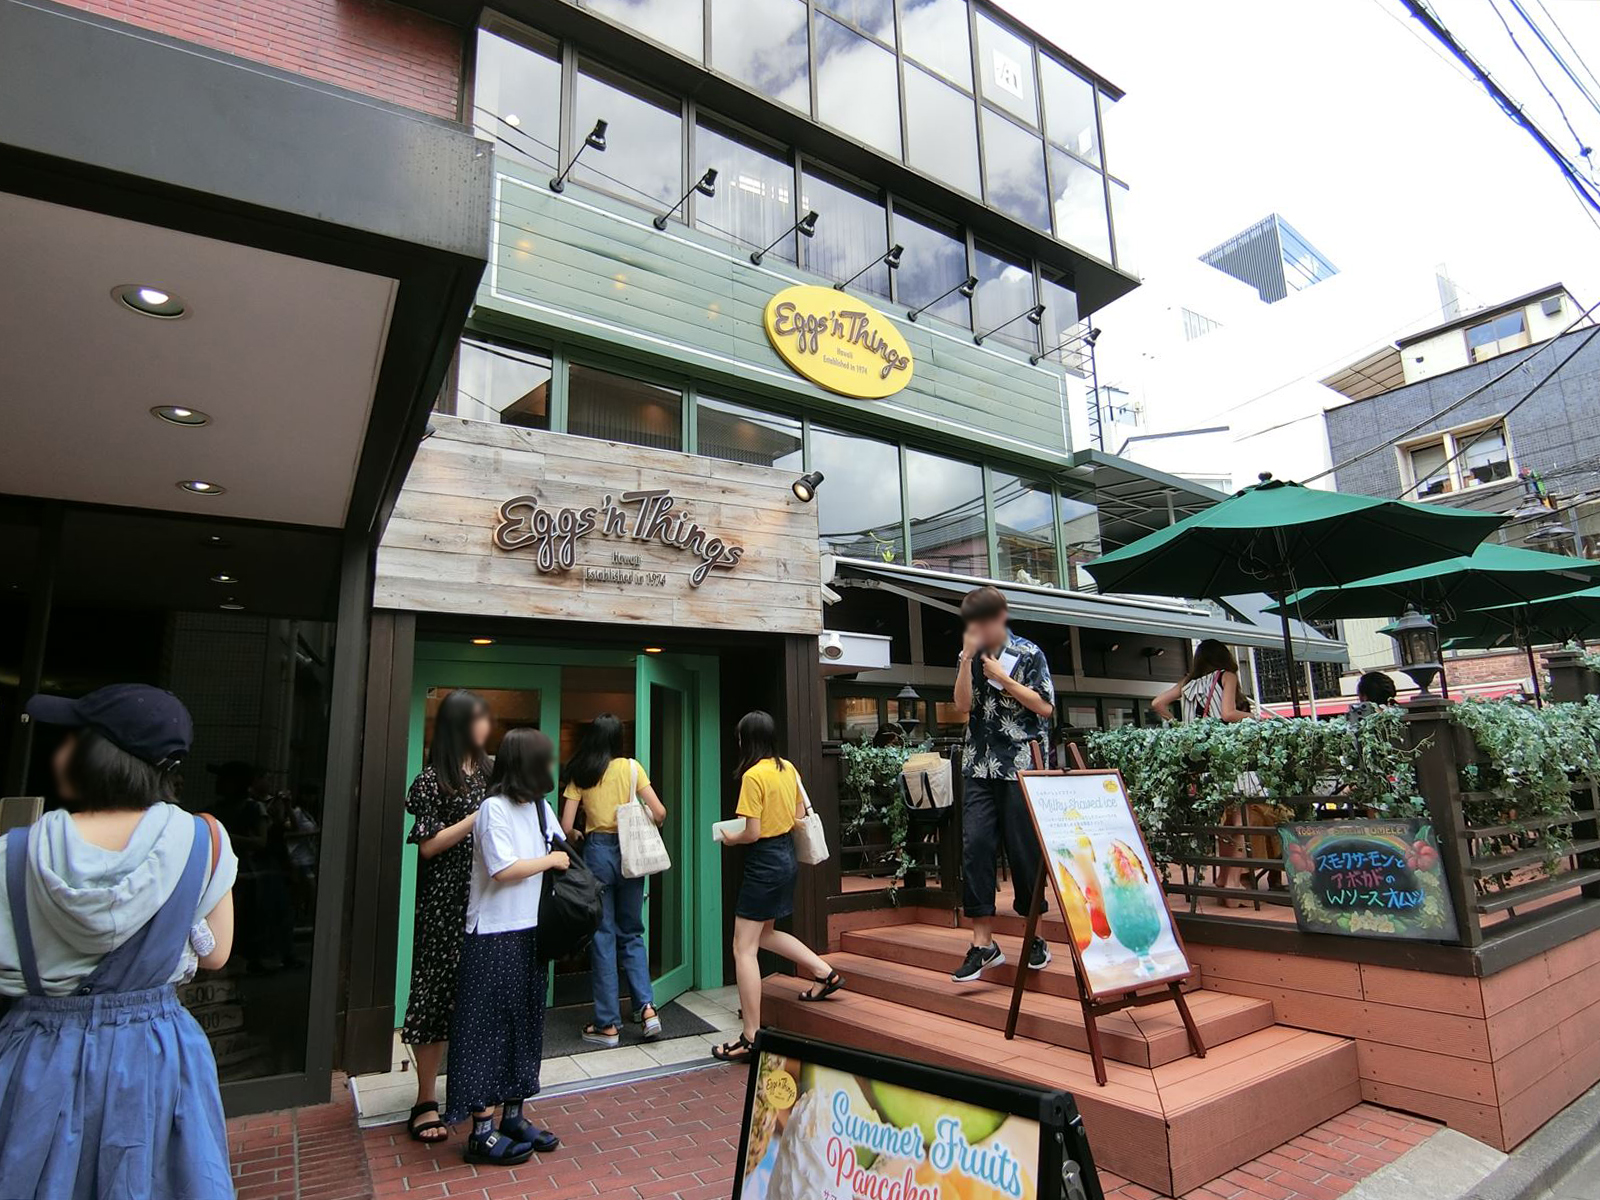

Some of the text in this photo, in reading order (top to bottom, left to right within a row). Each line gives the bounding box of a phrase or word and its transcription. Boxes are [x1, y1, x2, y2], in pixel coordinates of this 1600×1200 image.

[839, 310, 910, 379] Things
[620, 489, 745, 588] Things
[585, 567, 667, 587] Established in 1974
[1039, 797, 1067, 815] Milky
[1316, 851, 1406, 872] スモークサーモンと
[1331, 867, 1396, 889] アボカドの
[832, 1091, 1021, 1197] Summer Fruits
